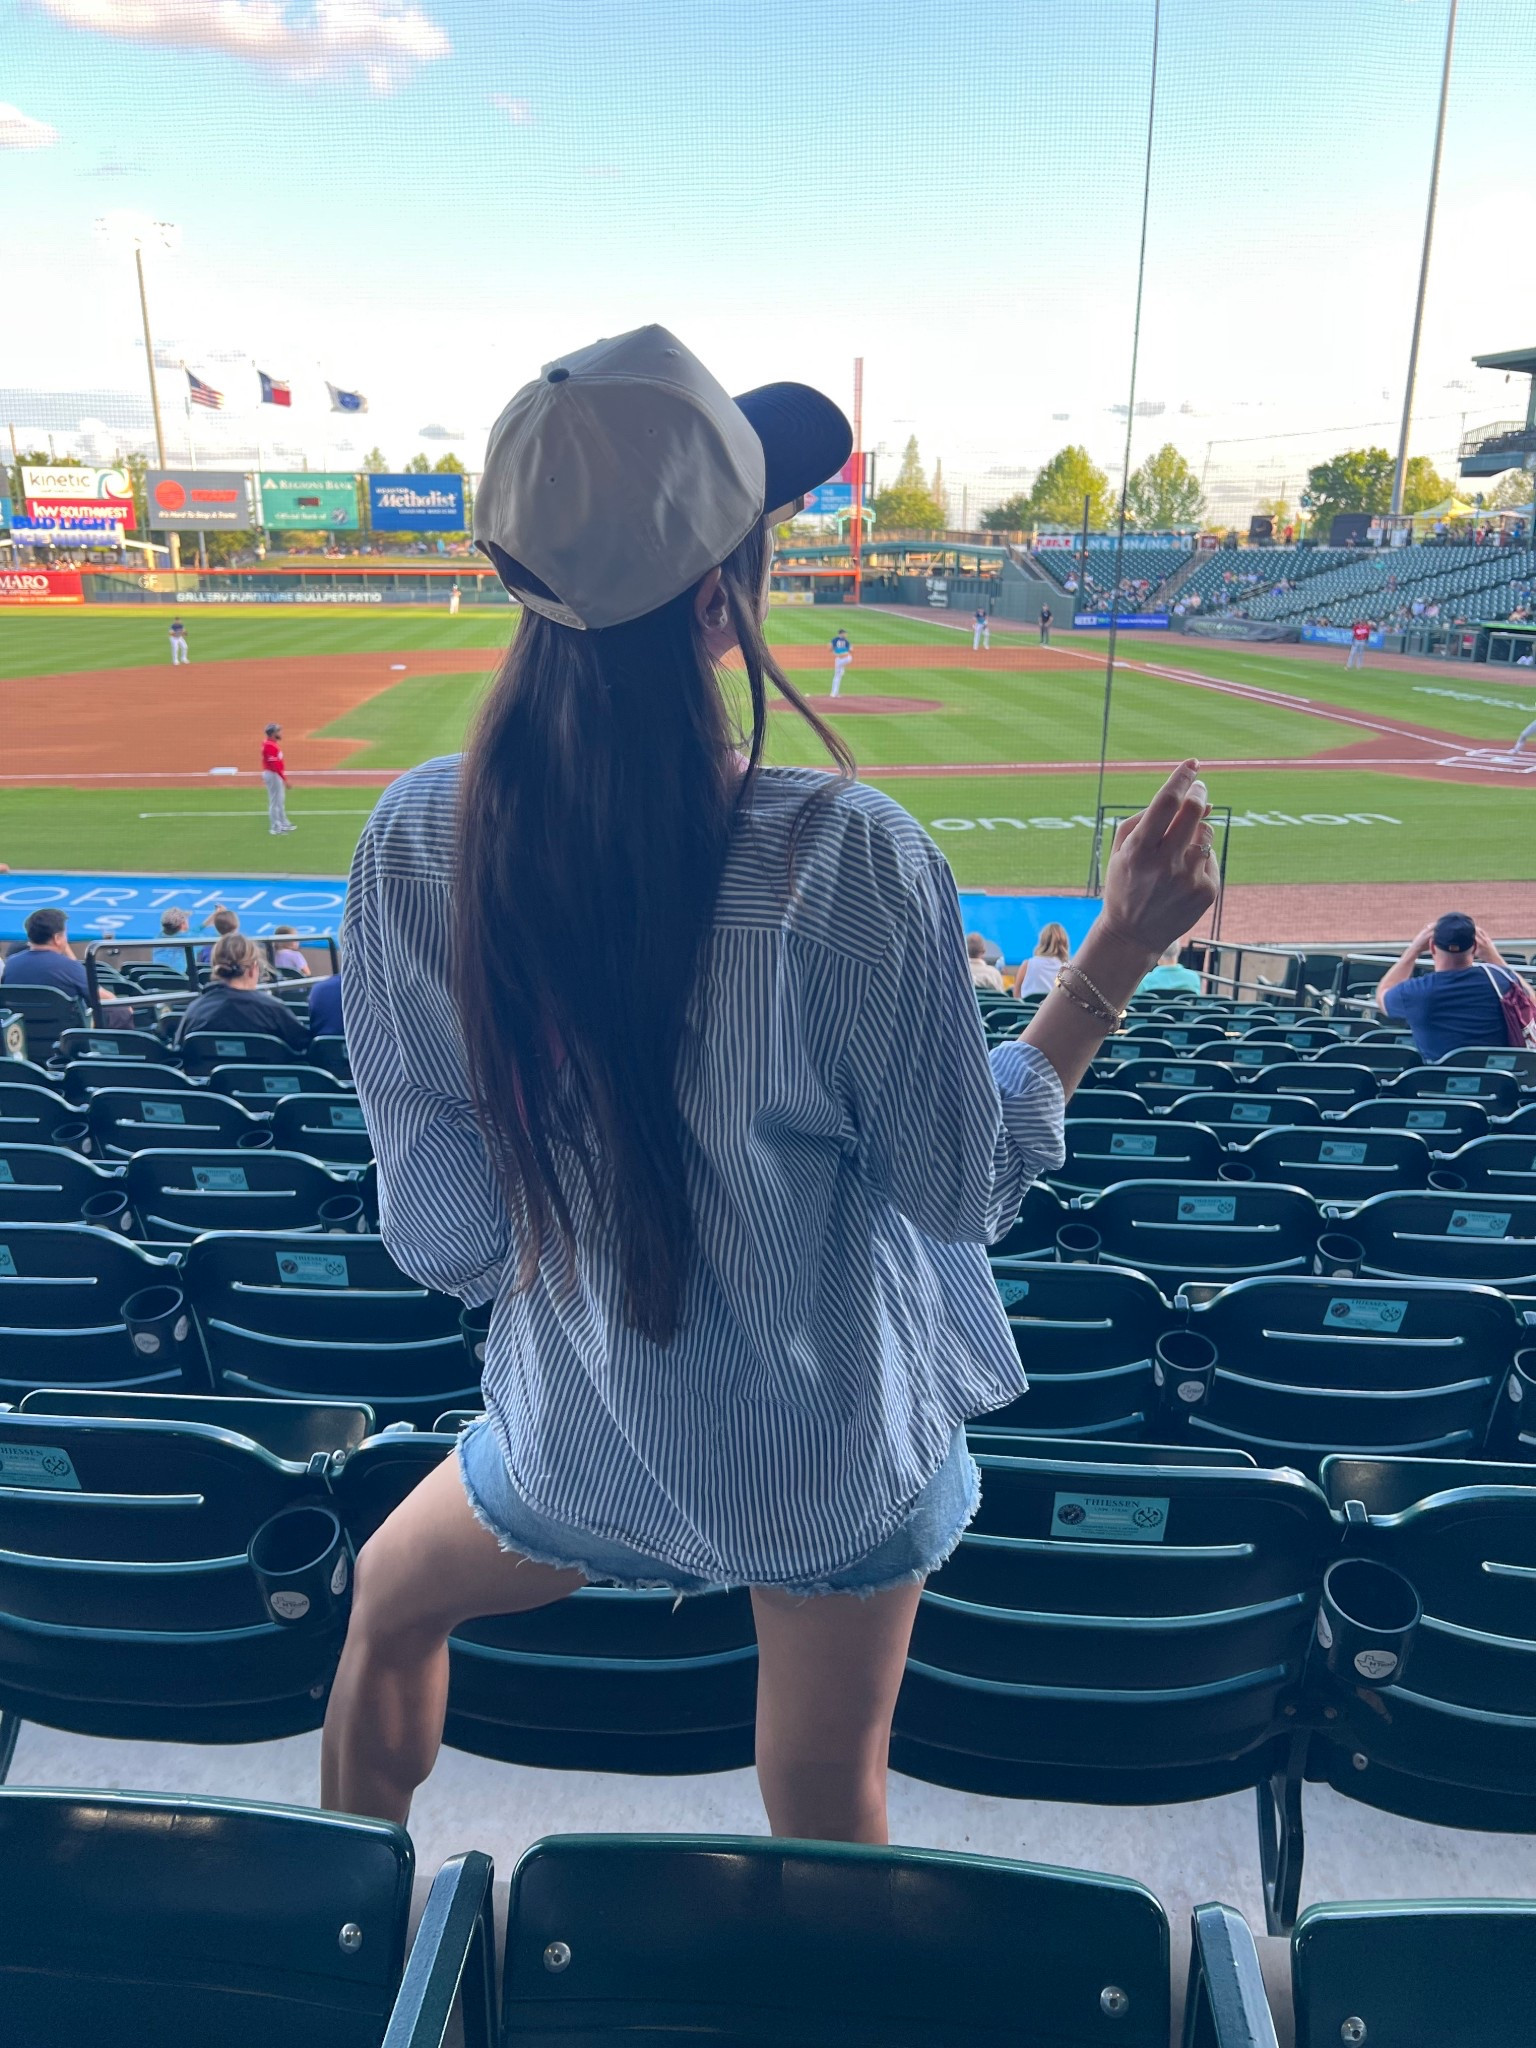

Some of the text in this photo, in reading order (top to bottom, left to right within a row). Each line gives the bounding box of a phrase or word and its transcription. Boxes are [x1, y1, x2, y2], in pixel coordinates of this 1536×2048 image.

[29, 472, 91, 487] kinetic
[377, 490, 457, 508] Methodist
[60, 505, 128, 519] SOUTHWEST
[11, 516, 117, 530] BUD LIGHT
[176, 592, 382, 602] GALLERY FURNITURE BULLPEN PATIO
[0, 1447, 44, 1456] HIESSEN
[1084, 1498, 1140, 1508] THIESSEN
